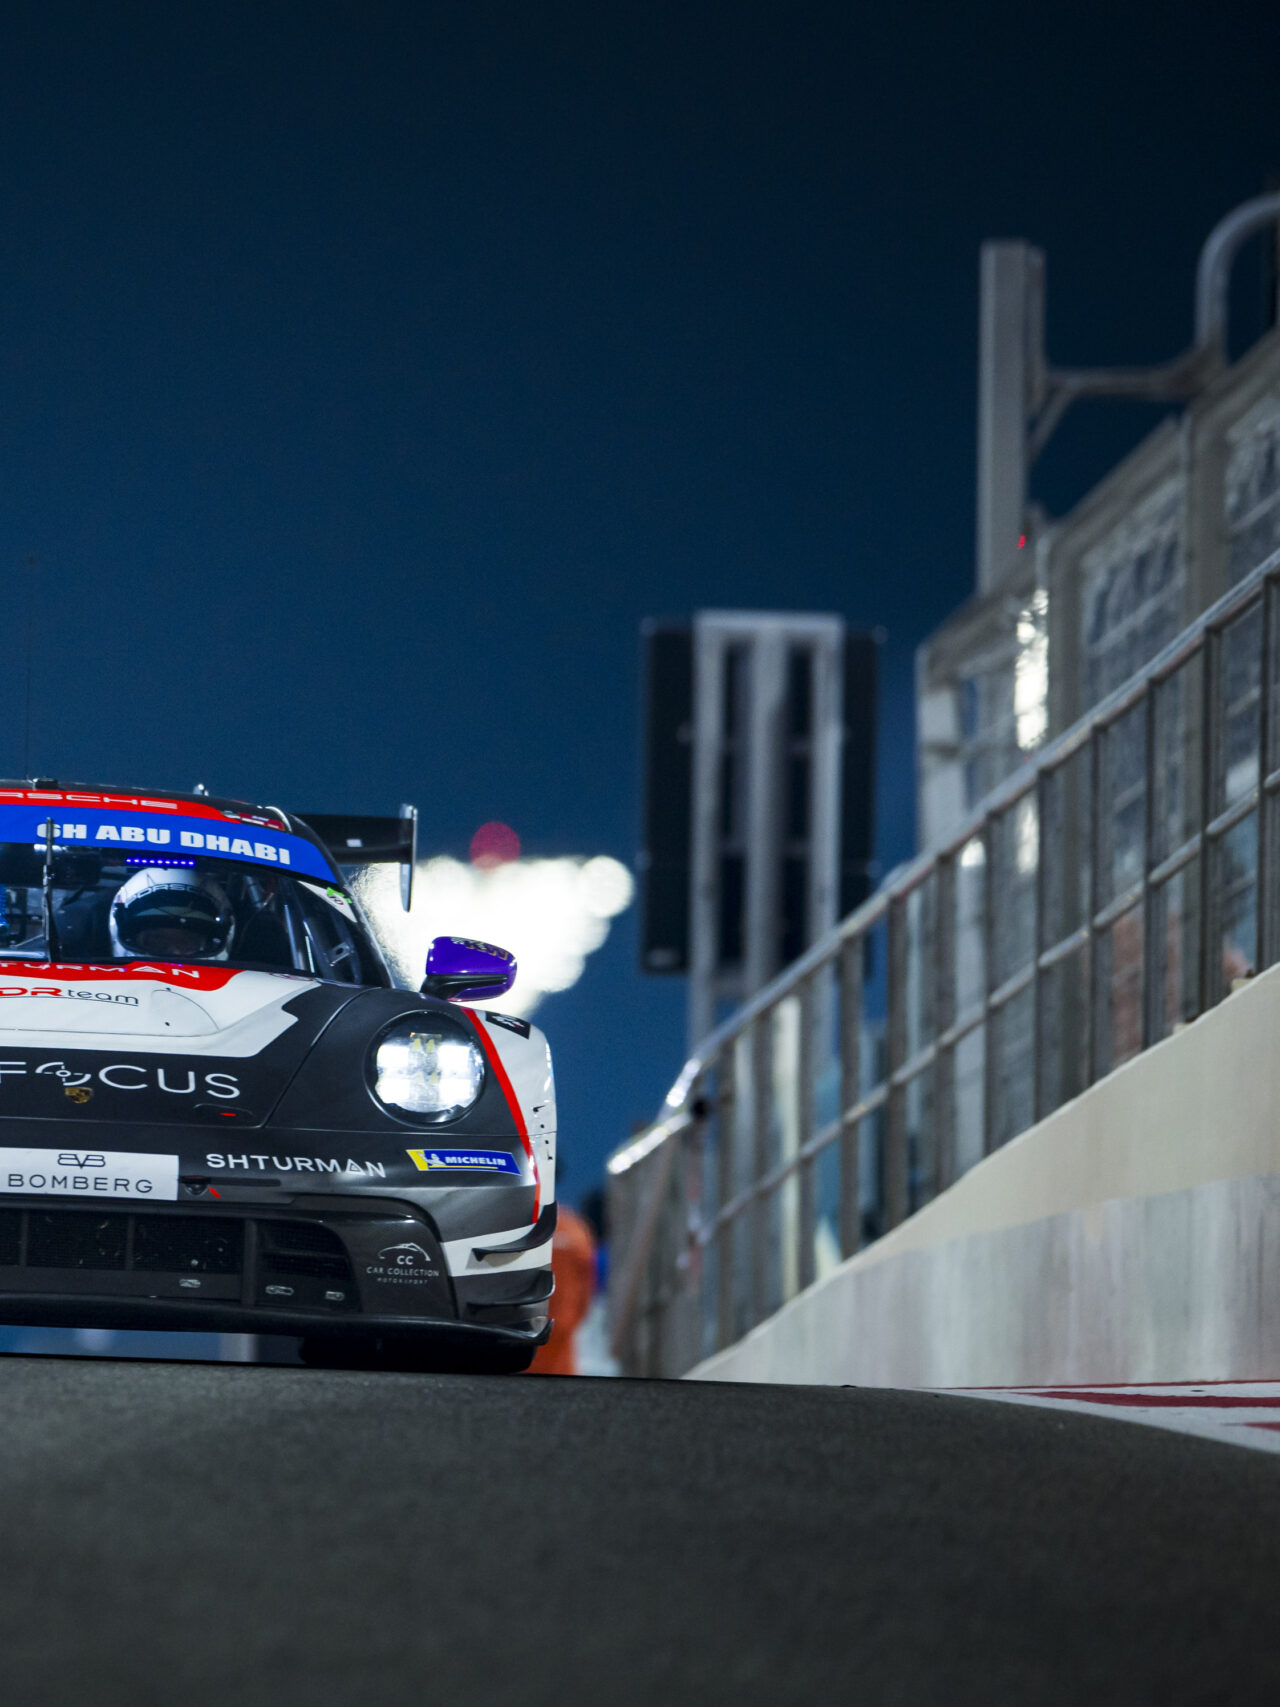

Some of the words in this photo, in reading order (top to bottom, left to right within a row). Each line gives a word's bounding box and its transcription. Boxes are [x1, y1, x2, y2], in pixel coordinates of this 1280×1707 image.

[36, 823, 87, 840] 6H
[95, 825, 171, 845] ABU
[180, 831, 291, 866] DHABI
[206, 1153, 387, 1178] SHTURMAN
[445, 1156, 507, 1167] MICHELIN
[7, 1174, 153, 1193] BOMBERG
[366, 1266, 384, 1274] CAR
[387, 1267, 440, 1277] COLLECTION
